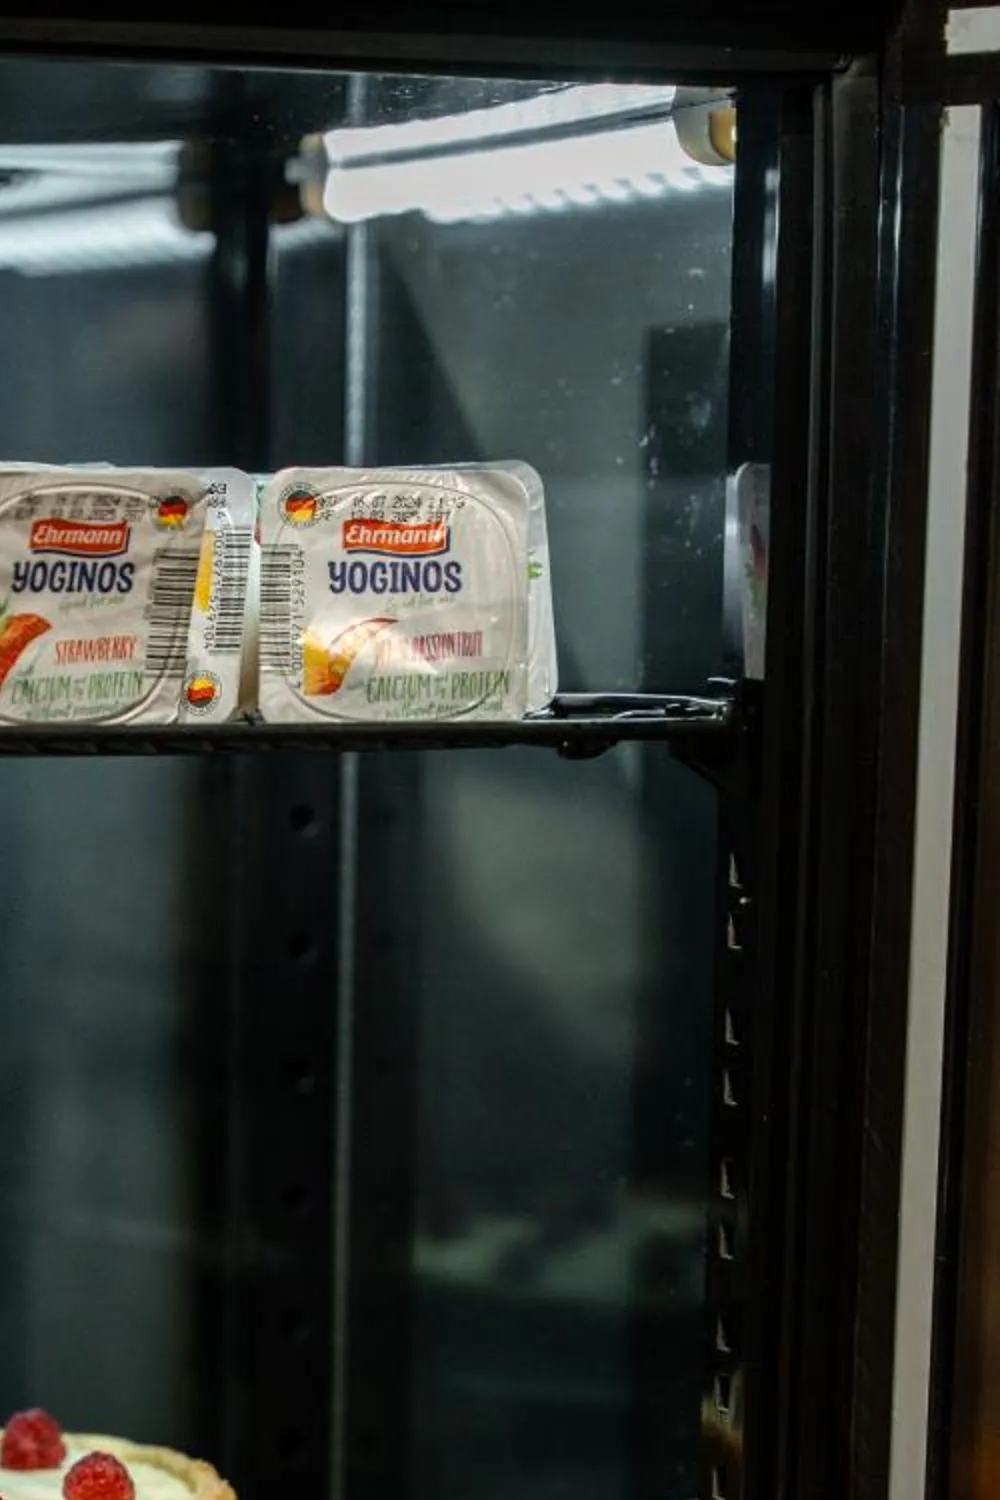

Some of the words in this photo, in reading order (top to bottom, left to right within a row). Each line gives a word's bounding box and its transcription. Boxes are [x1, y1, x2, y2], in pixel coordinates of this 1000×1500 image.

[33, 524, 123, 545] Ehrmann
[345, 524, 446, 545] Ehrmann
[12, 561, 136, 594] YOGINOS
[328, 561, 463, 594] YOGINOS
[55, 635, 138, 665] STRAWBERRY
[366, 673, 432, 703] CALCIUM
[451, 669, 511, 700] PROTEIN
